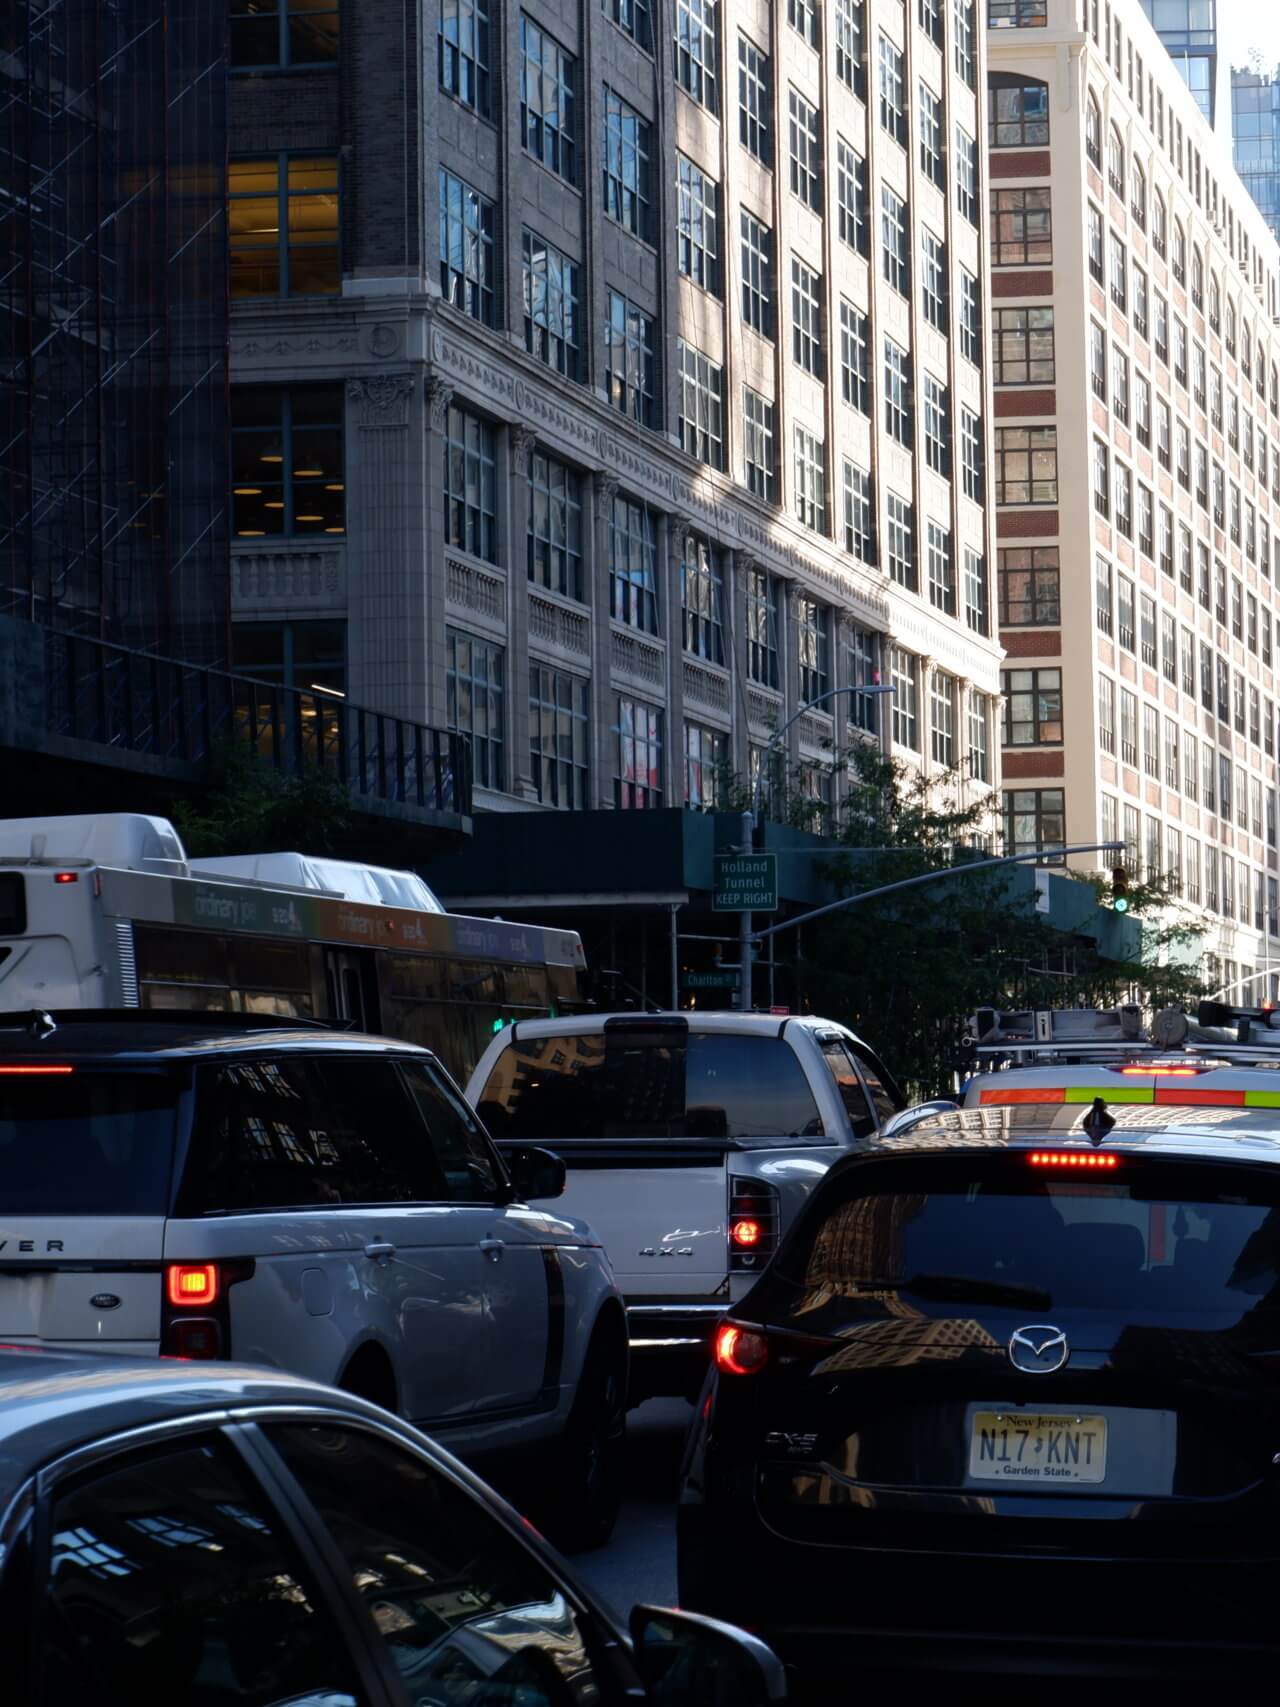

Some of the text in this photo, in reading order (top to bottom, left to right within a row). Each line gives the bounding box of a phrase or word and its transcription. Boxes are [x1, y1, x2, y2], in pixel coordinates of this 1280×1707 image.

[721, 859, 768, 873] Holland
[724, 876, 765, 889] Tunnel
[716, 892, 774, 905] KEEP RIGHT
[688, 974, 723, 985] Charlton
[1007, 1415, 1073, 1429] New Jersey
[1003, 1464, 1072, 1477] Garden State
